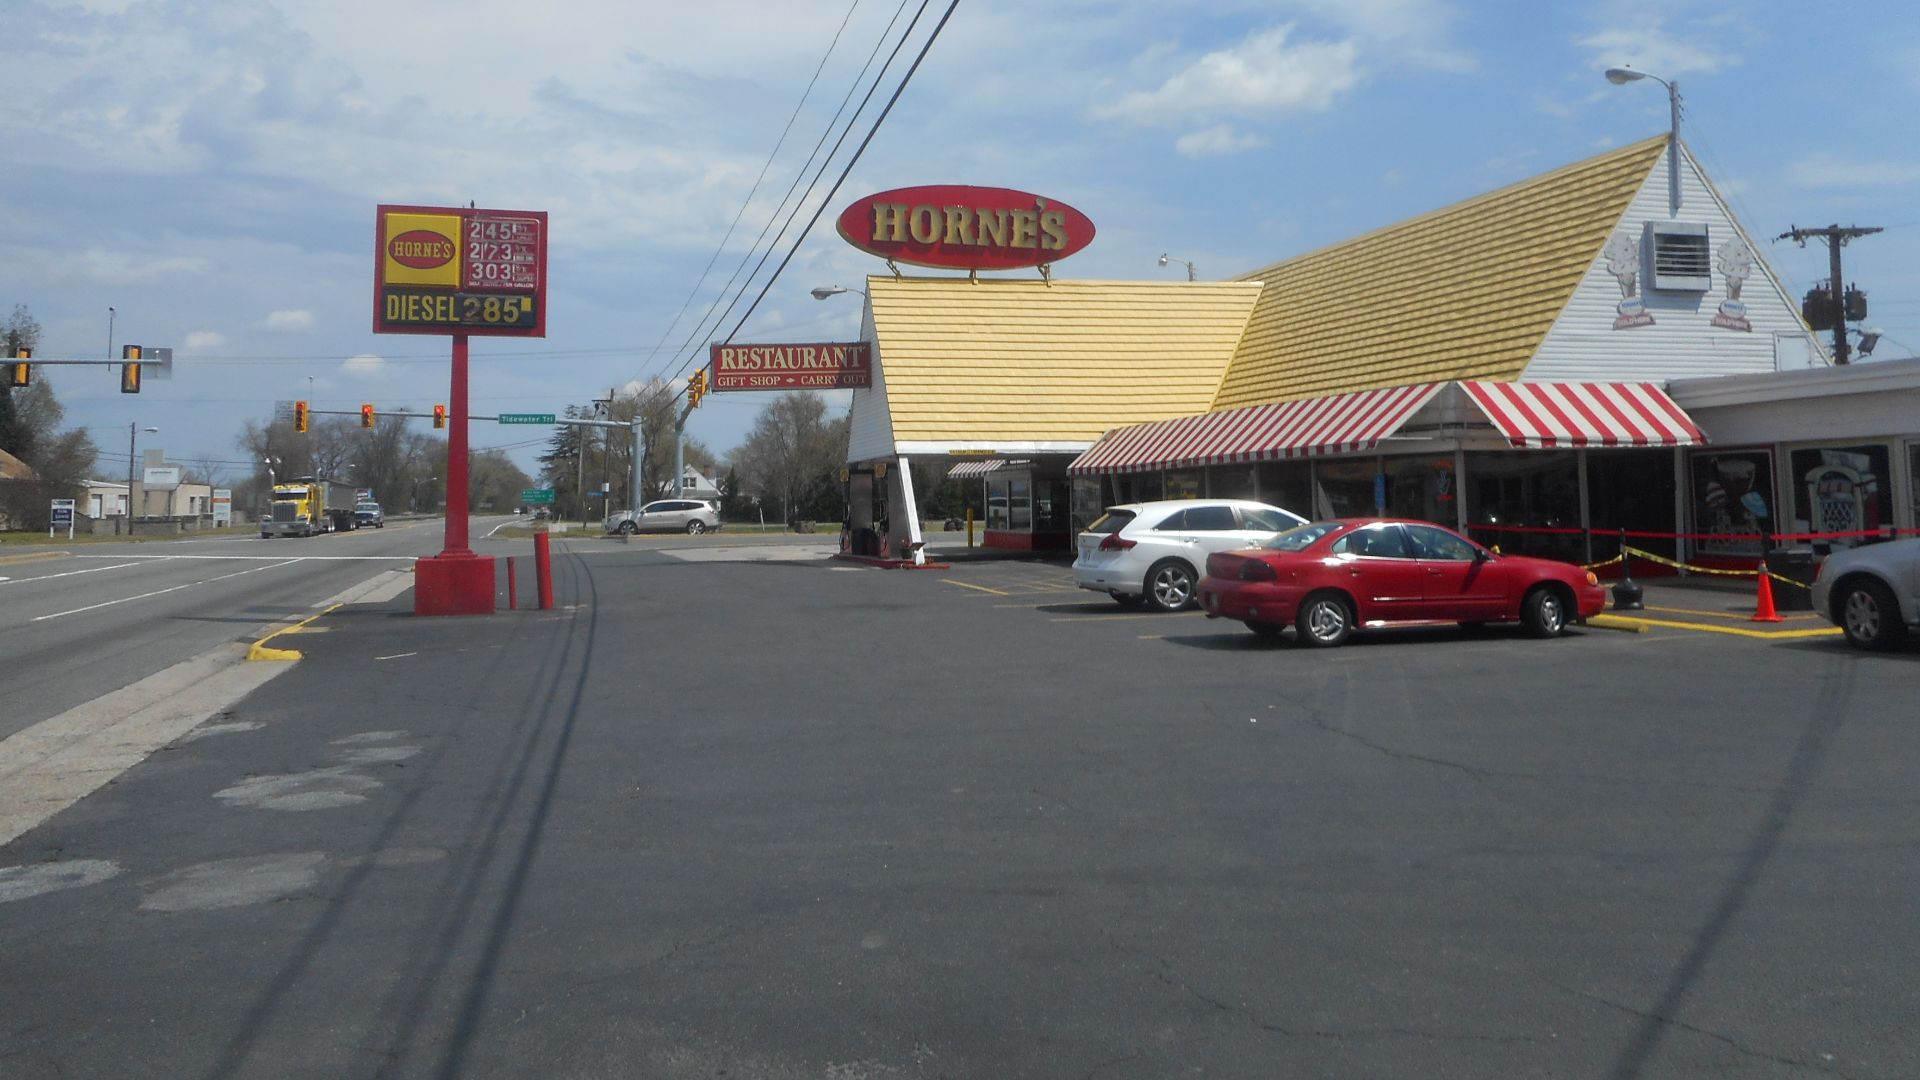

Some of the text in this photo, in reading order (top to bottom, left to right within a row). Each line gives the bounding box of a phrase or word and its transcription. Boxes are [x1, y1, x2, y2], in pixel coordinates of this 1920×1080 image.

[872, 197, 1069, 250] HORNE'S
[394, 241, 451, 259] HORNE'S
[471, 262, 512, 280] 303
[387, 294, 519, 323] DIESEL 285
[720, 346, 867, 370] RESTAURANT
[718, 374, 867, 387] GIFT SHOP CARRY OUT
[501, 415, 540, 423] Tidewater
